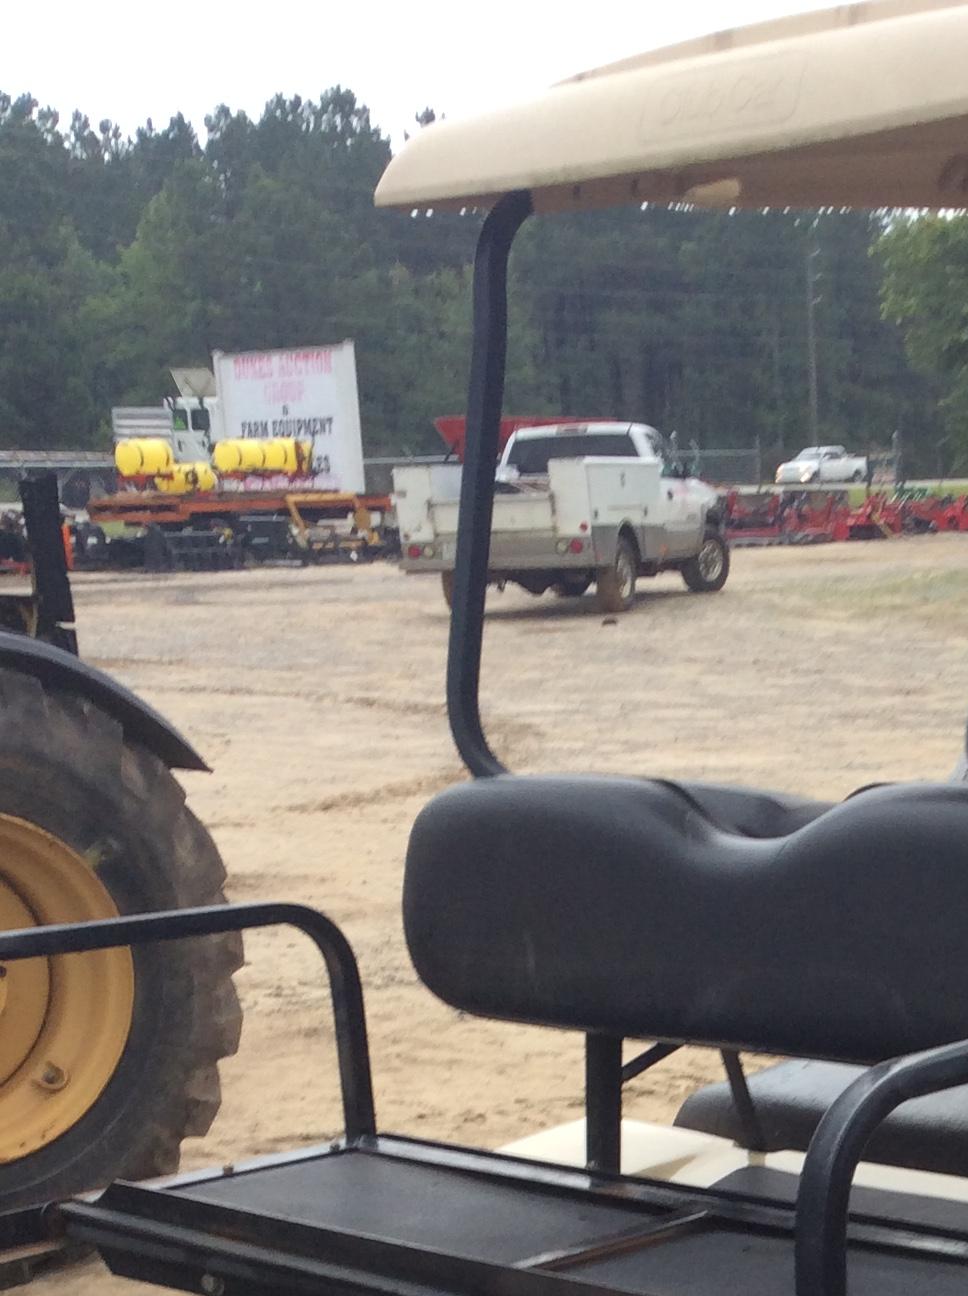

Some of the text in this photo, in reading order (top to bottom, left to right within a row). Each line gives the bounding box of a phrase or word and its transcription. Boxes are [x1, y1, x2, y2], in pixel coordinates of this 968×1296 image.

[278, 350, 333, 377] AUCTION
[241, 417, 333, 439] FARM EQUIPMENT
